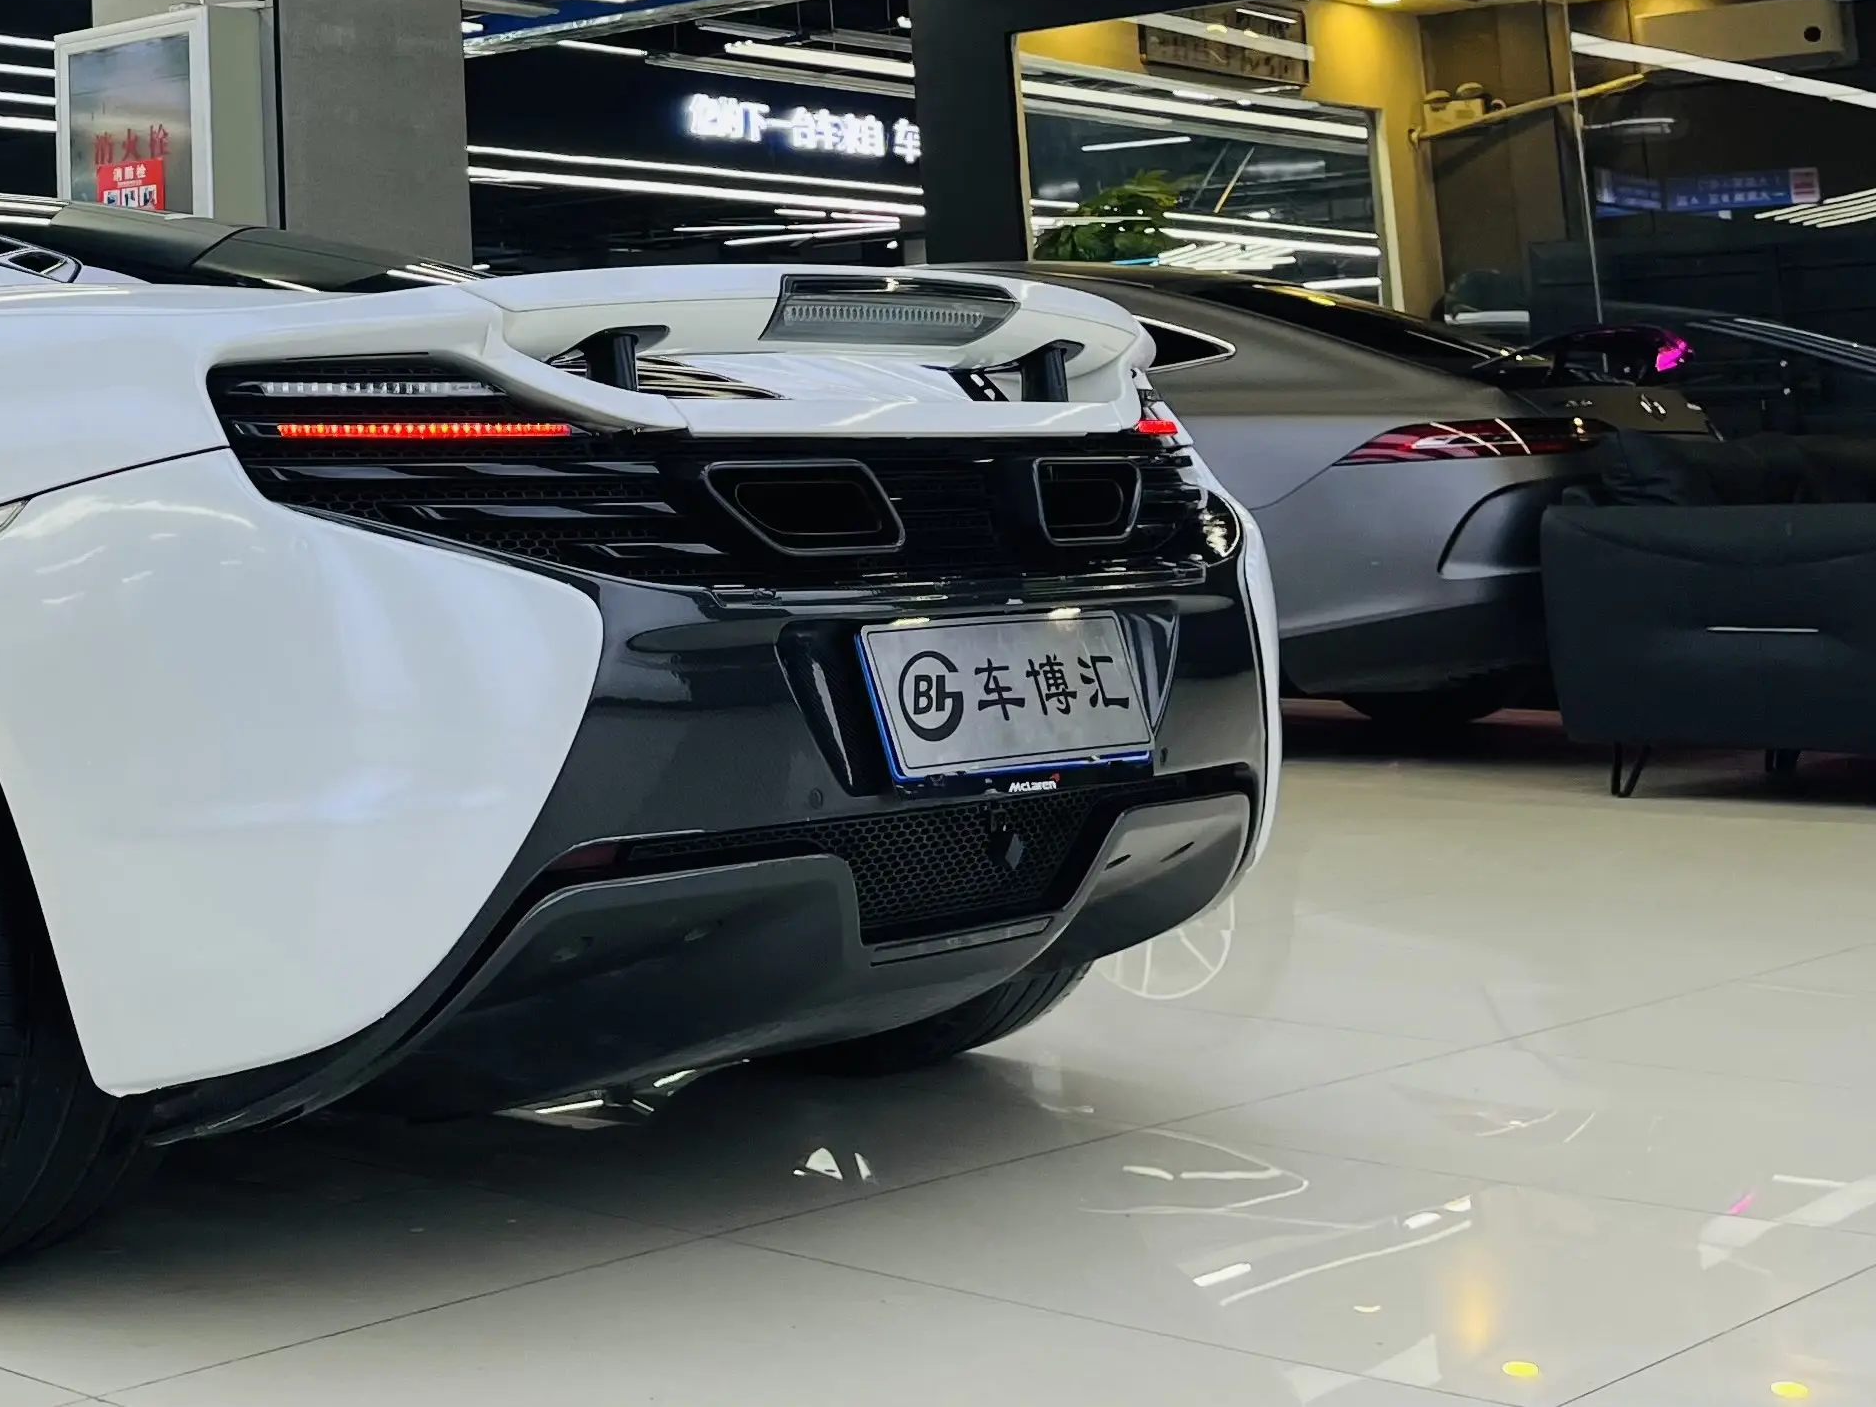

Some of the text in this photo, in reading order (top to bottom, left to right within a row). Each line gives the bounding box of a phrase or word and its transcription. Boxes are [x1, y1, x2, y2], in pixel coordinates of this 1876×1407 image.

[975, 654, 1129, 721] 车博汇
[1008, 780, 1057, 793] McLaren
